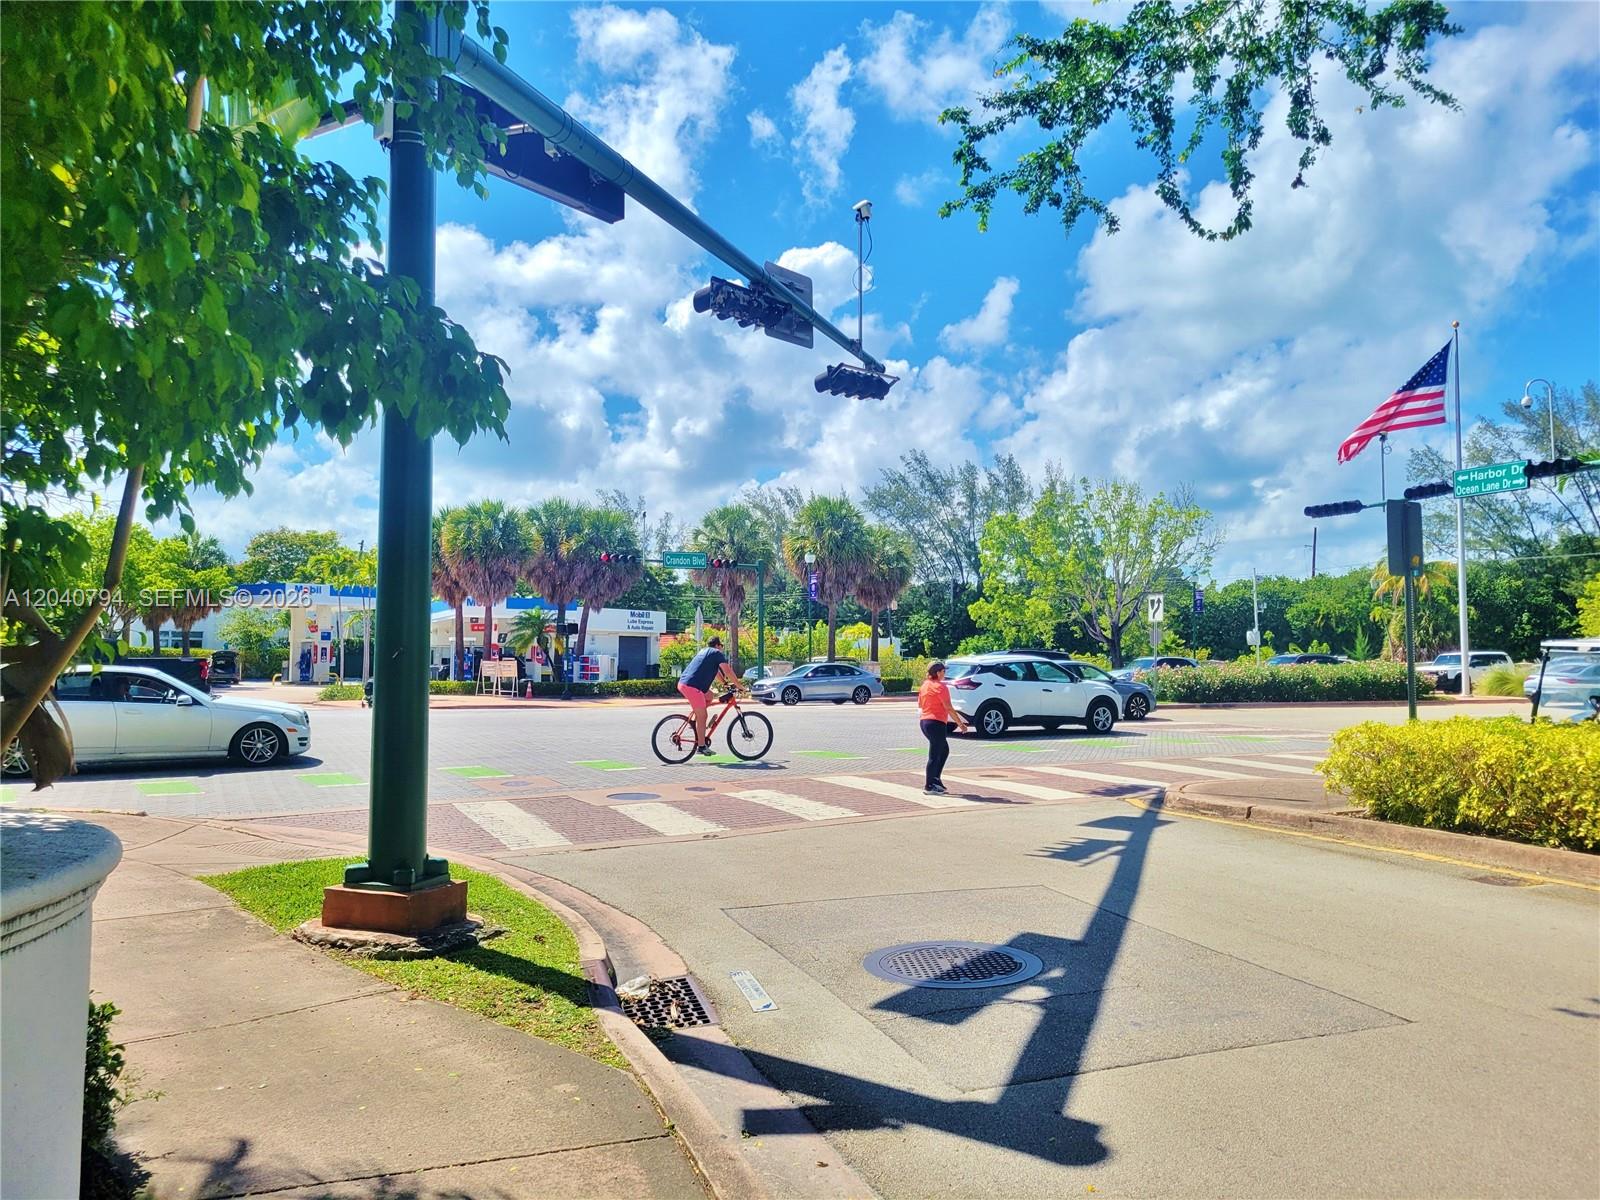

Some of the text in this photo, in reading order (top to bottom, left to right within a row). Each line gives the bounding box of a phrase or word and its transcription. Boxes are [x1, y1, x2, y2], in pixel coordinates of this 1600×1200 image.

[1470, 465, 1524, 481] Harbor Dr
[1456, 479, 1511, 495] Ocean Lane Dr
[665, 555, 705, 565] Crandon Blvd
[294, 585, 322, 594] Mobil
